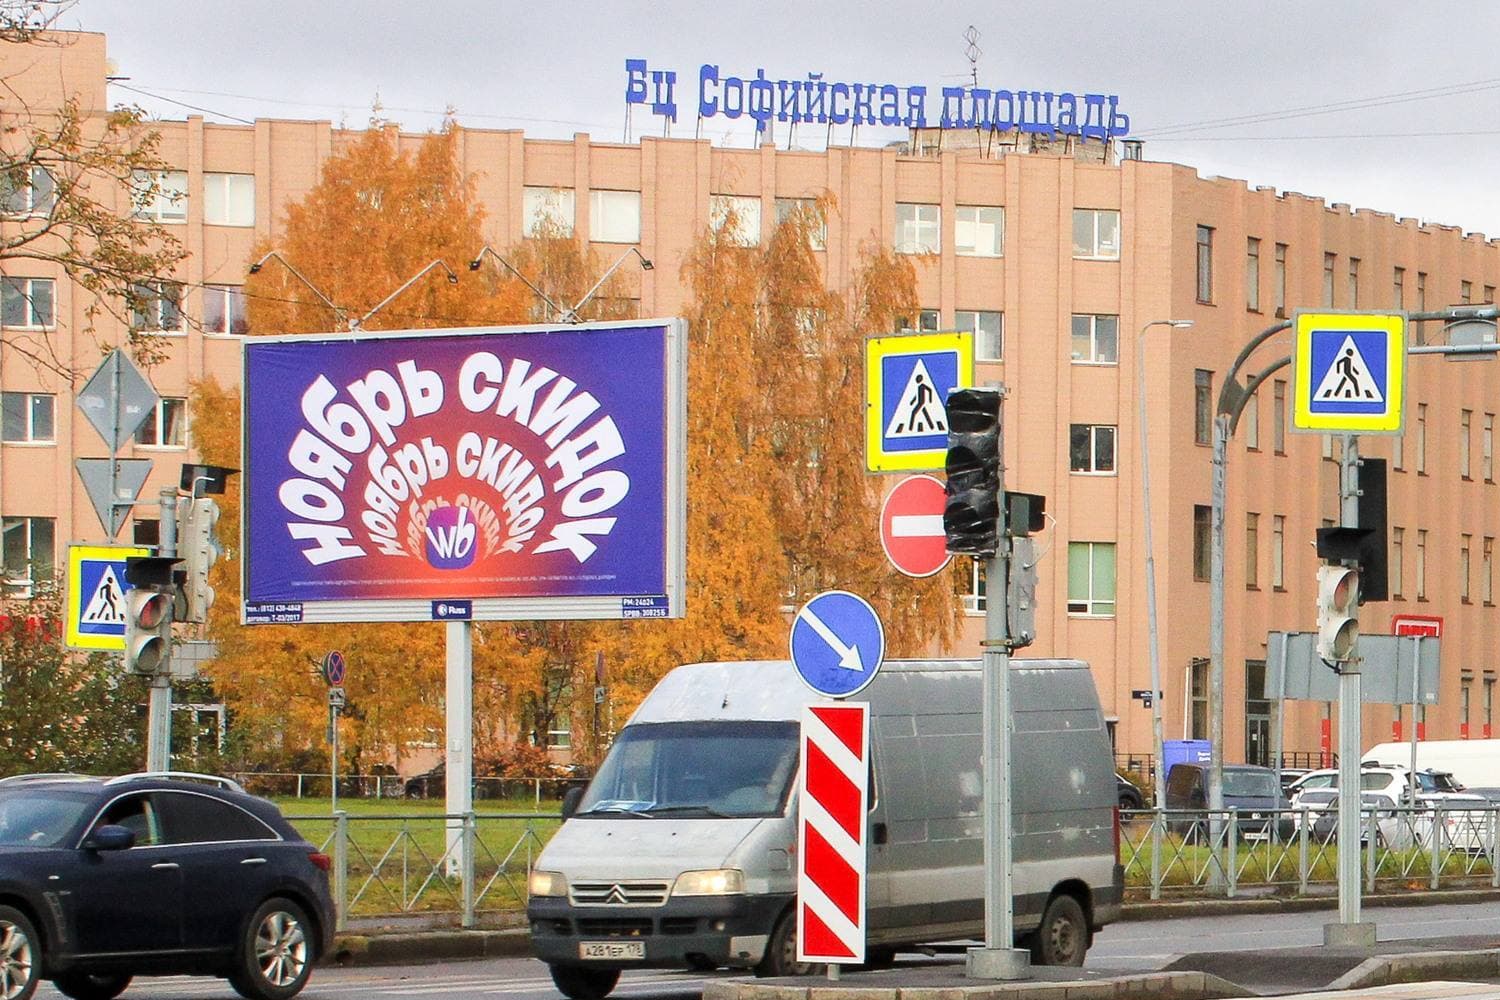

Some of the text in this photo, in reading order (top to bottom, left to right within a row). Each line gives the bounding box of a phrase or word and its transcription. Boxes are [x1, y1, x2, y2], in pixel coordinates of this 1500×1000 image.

[699, 63, 927, 132] Софийская
[942, 86, 1130, 144] площадь
[278, 350, 631, 567] ноябрь скидок
